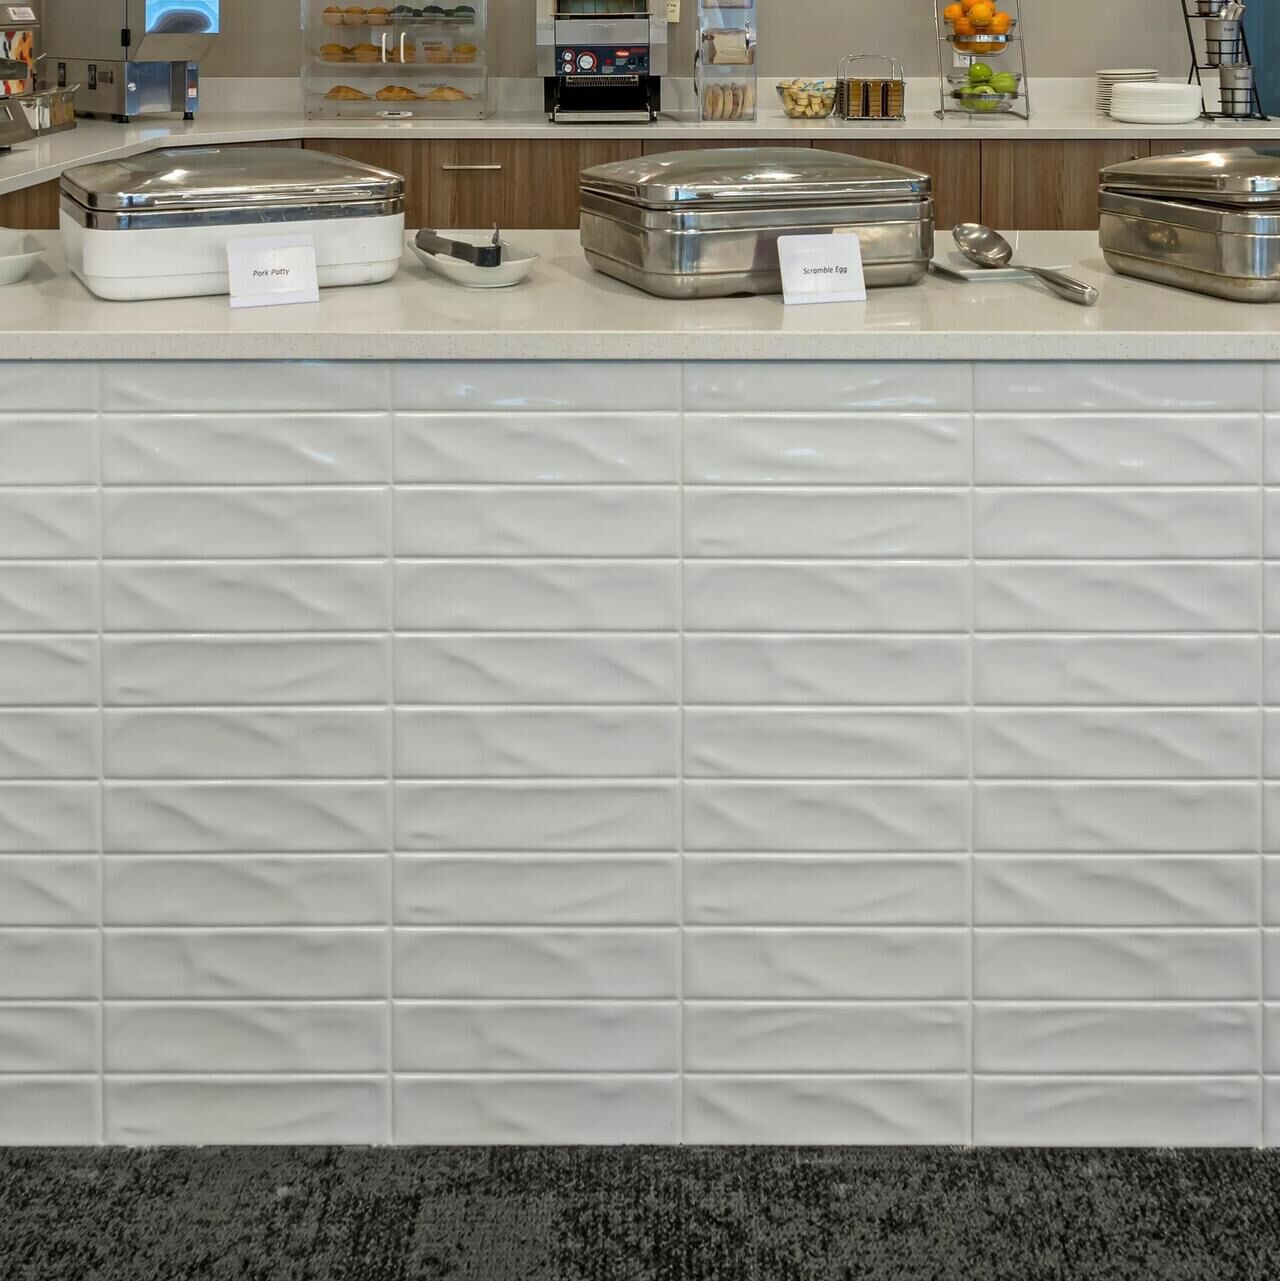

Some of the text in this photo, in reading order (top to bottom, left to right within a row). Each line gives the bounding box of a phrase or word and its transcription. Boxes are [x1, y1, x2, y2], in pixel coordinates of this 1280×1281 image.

[252, 268, 290, 277] Pork Patty
[803, 265, 848, 275] Scramble Egg
